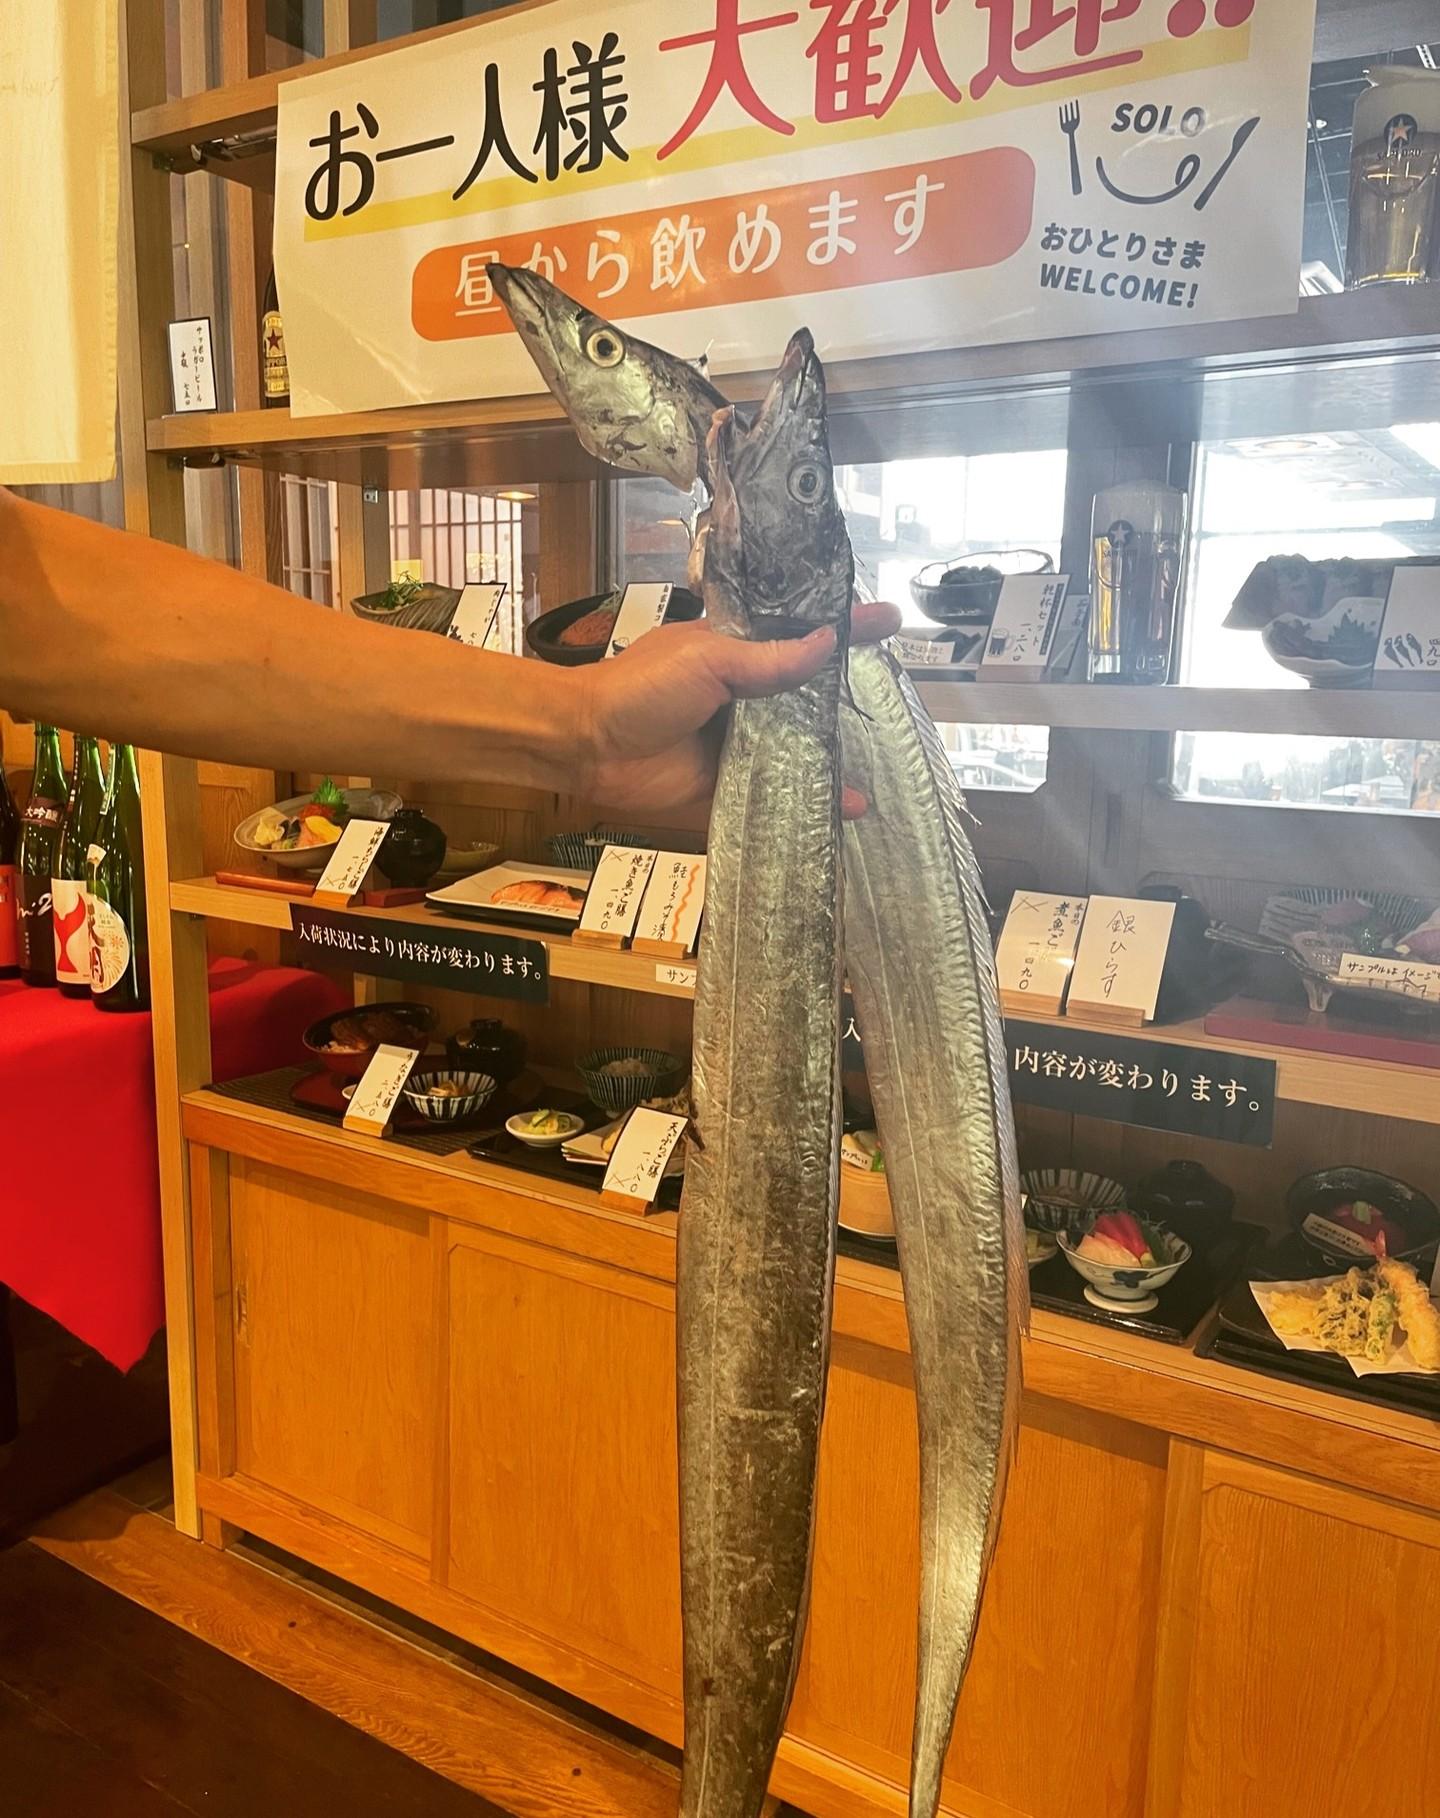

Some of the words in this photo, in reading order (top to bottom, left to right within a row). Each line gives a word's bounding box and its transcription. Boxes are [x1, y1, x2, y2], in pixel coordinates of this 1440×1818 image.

[305, 31, 629, 221] お一人様
[656, 0, 1256, 161] 大歓迎
[1110, 102, 1208, 138] SOLO
[455, 173, 945, 317] 昼から飲めます
[1038, 222, 1206, 271] おひとりさま
[1038, 262, 1198, 309] WELCOME!
[299, 922, 542, 981] 入荷状況により内容が変わります。
[1101, 909, 1137, 999] 銀ひらす
